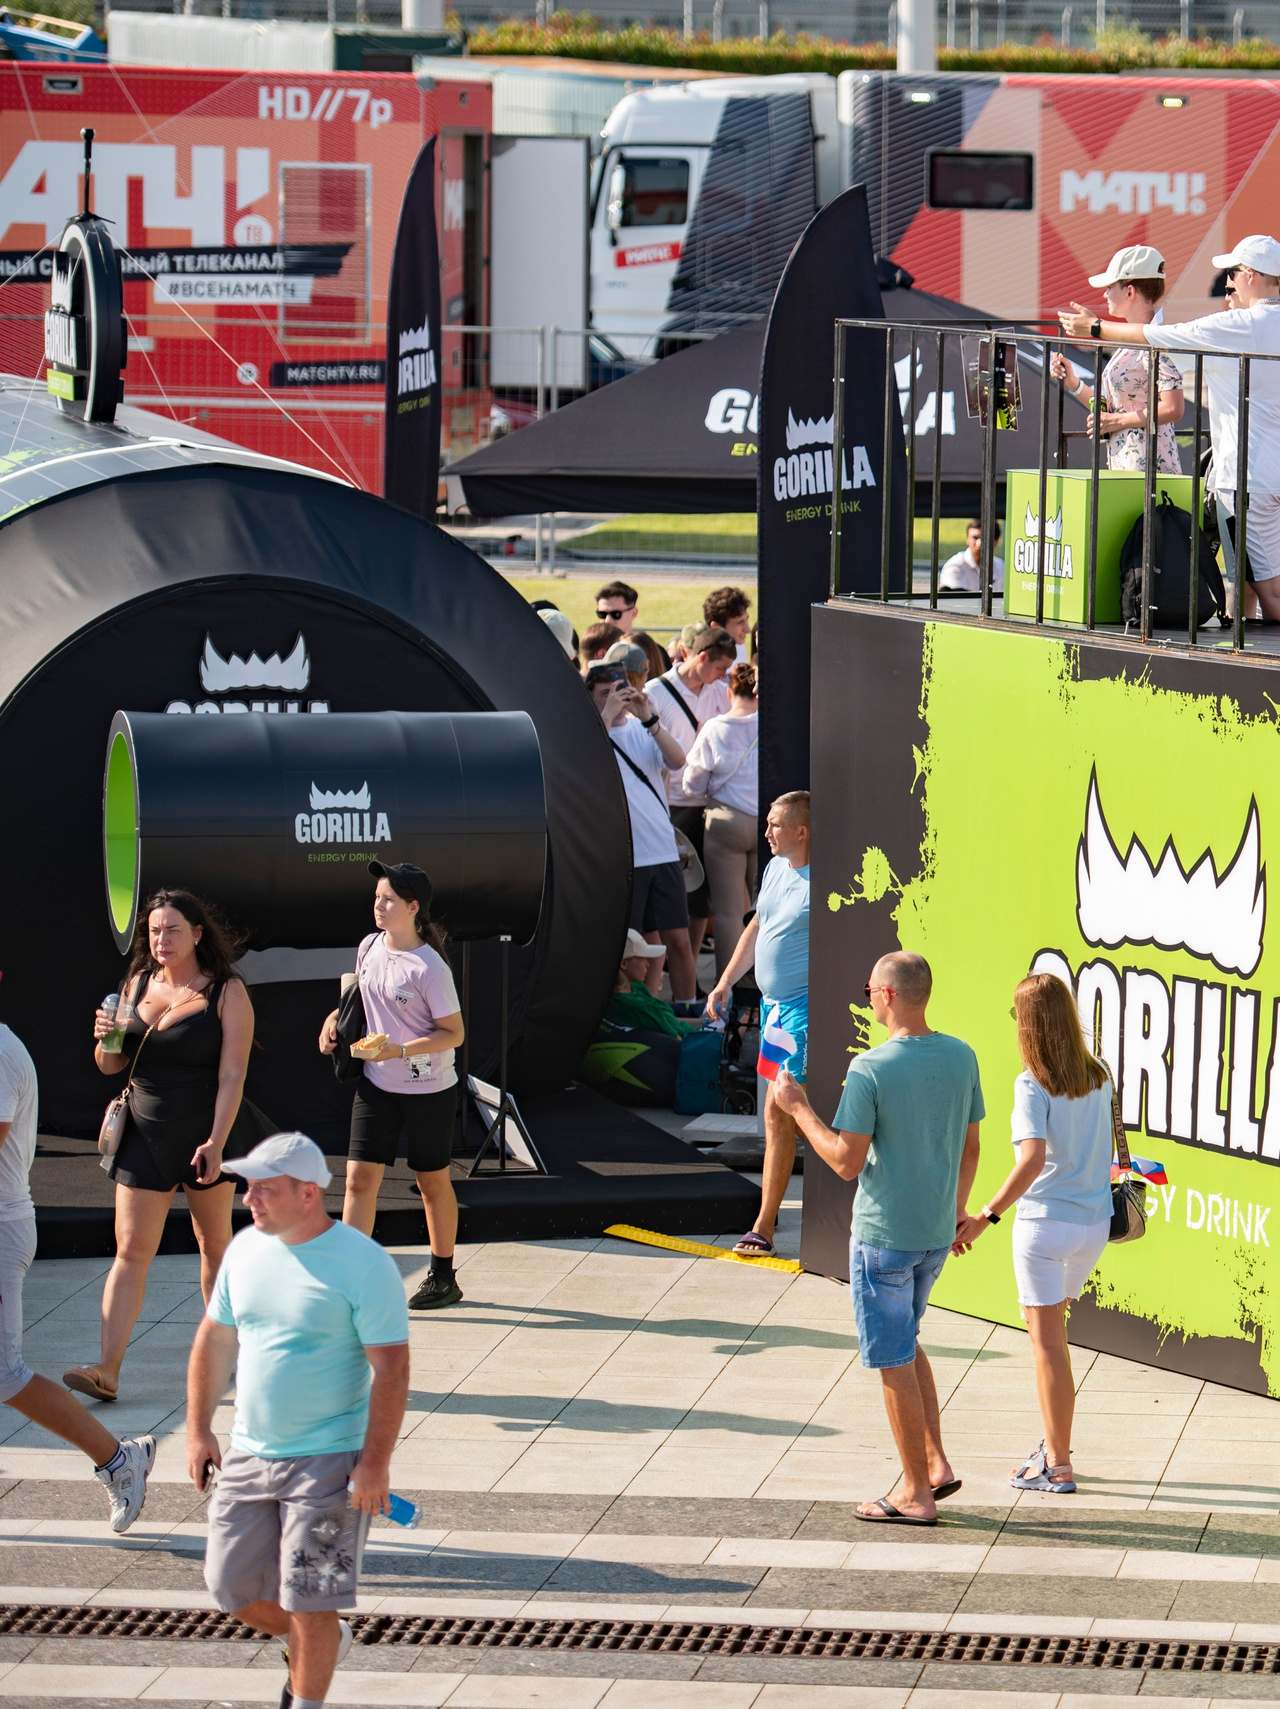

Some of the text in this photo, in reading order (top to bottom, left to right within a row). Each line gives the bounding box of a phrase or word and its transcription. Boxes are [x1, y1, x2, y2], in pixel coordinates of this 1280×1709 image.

[0, 140, 272, 249] АТЧ!
[172, 251, 284, 273] ТЕЛЕКАНАЛ
[168, 279, 296, 298] #ВСЕНАМАТЧ
[786, 500, 861, 522] ENERGY DINK
[295, 812, 391, 843] GORILLA
[308, 853, 378, 863] ENERGY DRINK
[1186, 1189, 1271, 1247] DRINK
